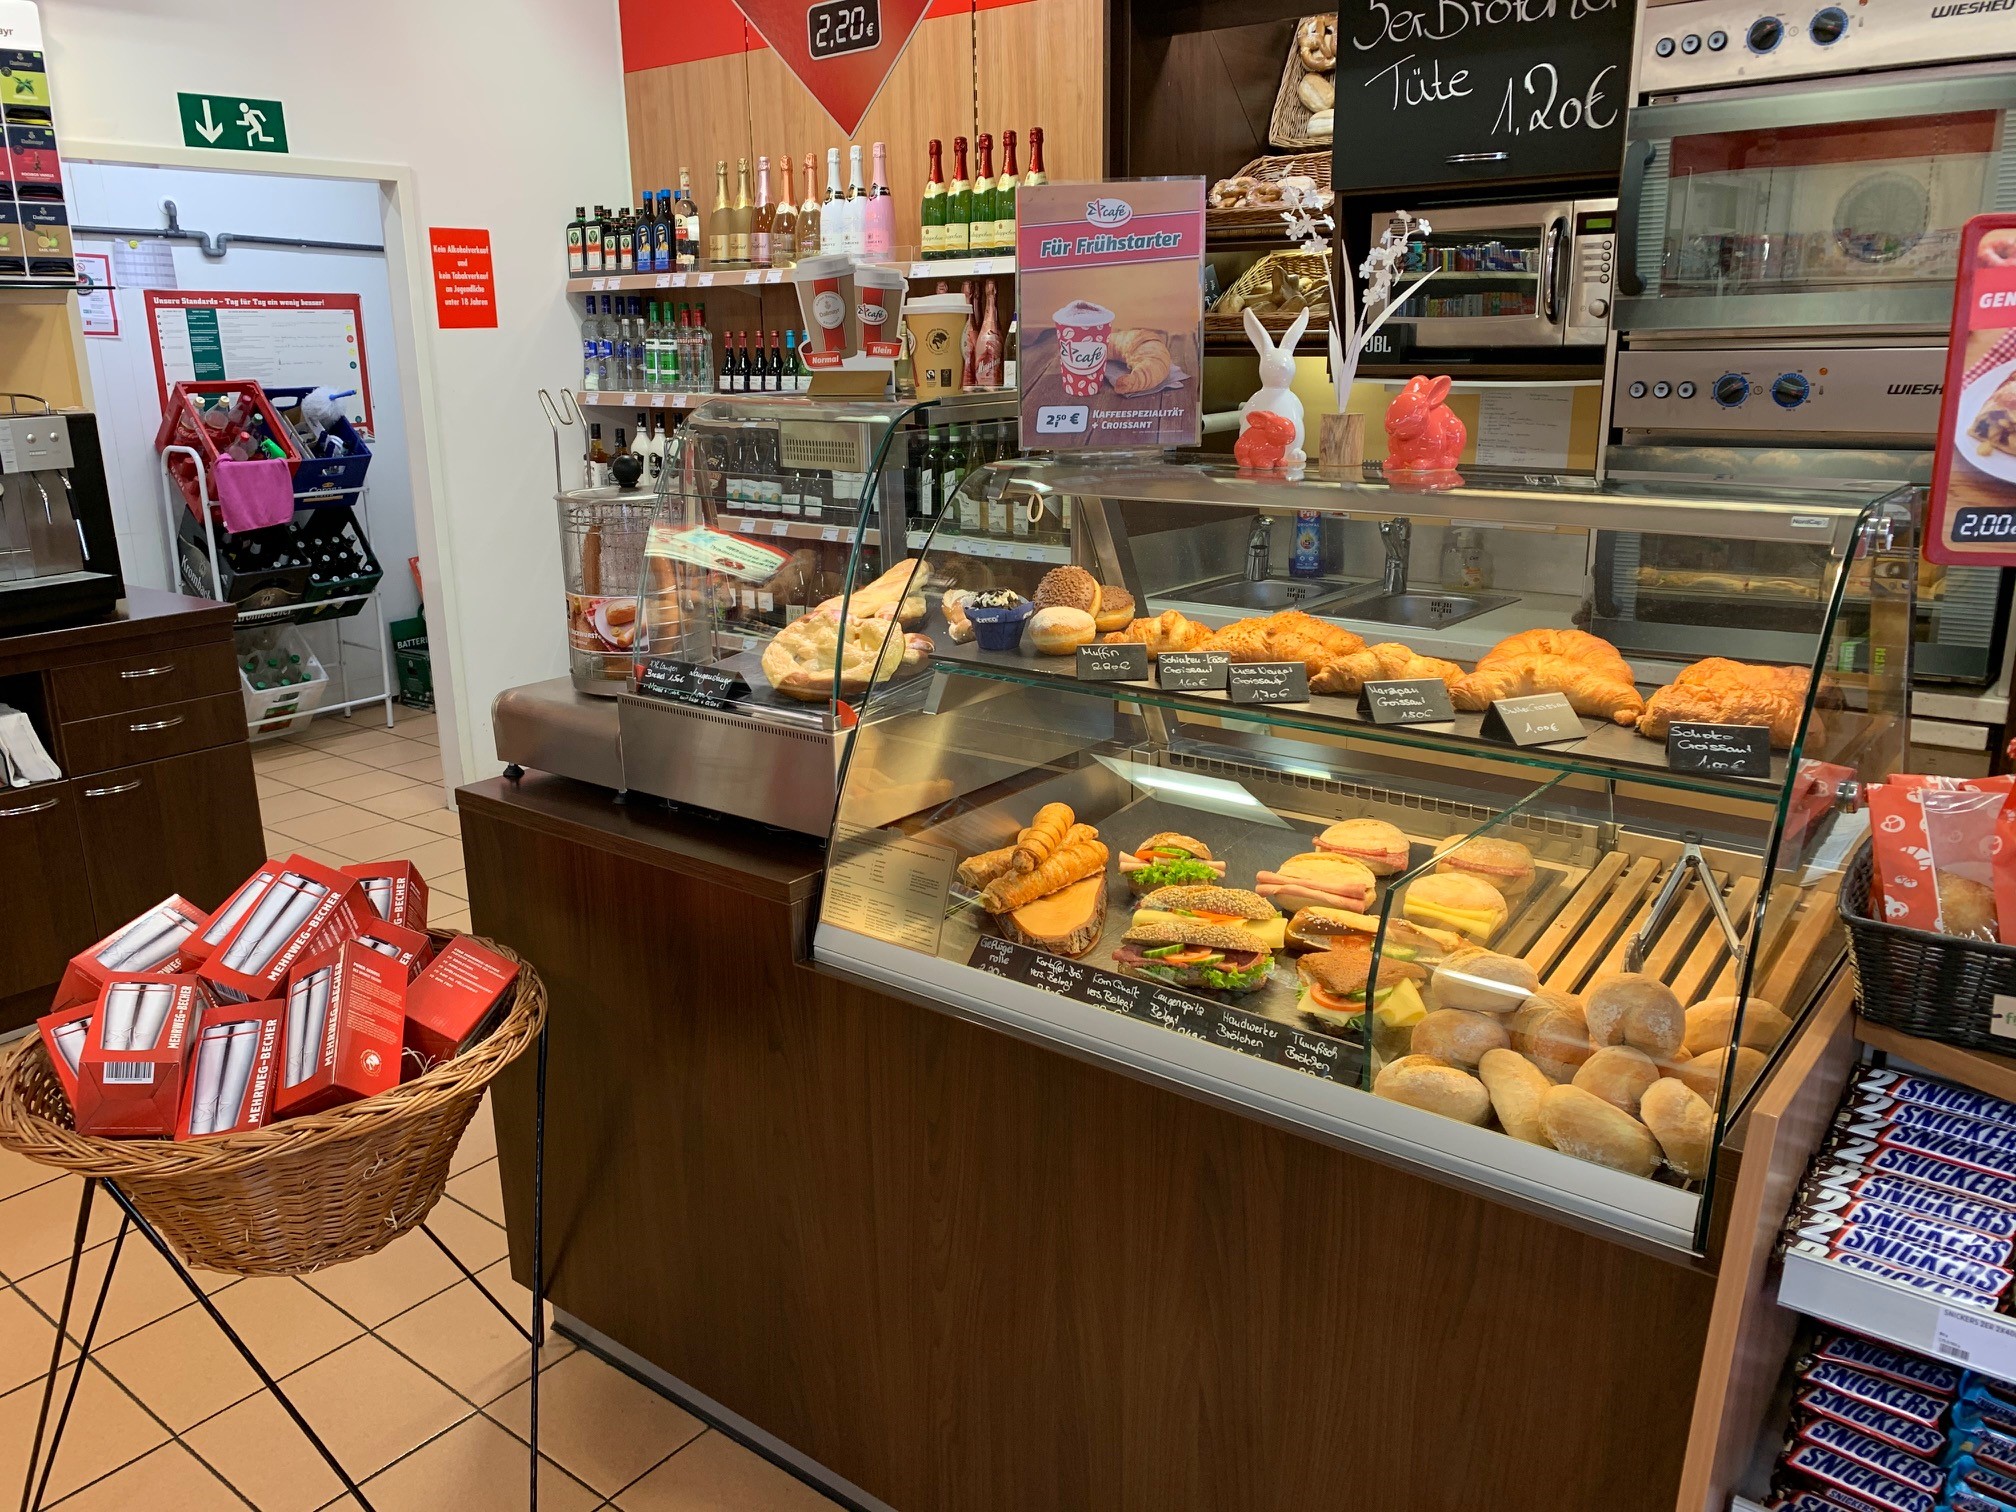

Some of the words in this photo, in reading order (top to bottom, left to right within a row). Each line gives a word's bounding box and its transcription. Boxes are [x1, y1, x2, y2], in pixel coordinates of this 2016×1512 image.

[1365, 54, 1474, 110] Tüte
[1040, 239, 1072, 258] Für
[1075, 231, 1182, 255] Frühstarter
[153, 296, 180, 304] Unsere
[181, 297, 218, 305] Standards
[225, 298, 239, 307] Tag
[240, 298, 252, 306] für
[253, 299, 266, 307] Tag
[280, 299, 300, 308] wenig
[301, 299, 325, 307] besser!
[812, 356, 839, 364] Normal
[873, 346, 892, 355] Klein
[1081, 648, 1120, 660] Muffin
[1678, 739, 1752, 754] Croissant
[267, 891, 342, 982] MEHRWEG-BECHER
[989, 953, 1010, 965] rolle
[1046, 970, 1073, 992] Belegt
[324, 961, 343, 1067] MEHRWEG-BECHER
[1103, 989, 1134, 1013] Belegt
[166, 984, 193, 1050] MEHRWEG-BECHER
[1215, 1022, 1264, 1048] Brötchen
[247, 1018, 278, 1124] MEHRWEG-BECHER
[1284, 1045, 1331, 1072] Brötchen
[1858, 1069, 1899, 1095] 2
[1854, 1093, 1895, 1118] 2
[1848, 1115, 1891, 1139] 2
[1834, 1138, 1880, 1164] 2
[1805, 1189, 1852, 1217] 2
[1819, 1165, 1862, 1192] 2
[1863, 1177, 2016, 1238] SNICKERS
[1797, 1213, 1845, 1245] 2
[1841, 1226, 2008, 1294] SNICKERS
[1944, 1309, 1979, 1326] SNICKERS
[1829, 1338, 1957, 1391] SNICKERS
[1812, 1362, 1949, 1421] SNICKERS
[1808, 1388, 1944, 1451] SNICKERS
[1812, 1420, 1945, 1488] SNICKERS
[1797, 1447, 1935, 1512] SNICKERS
